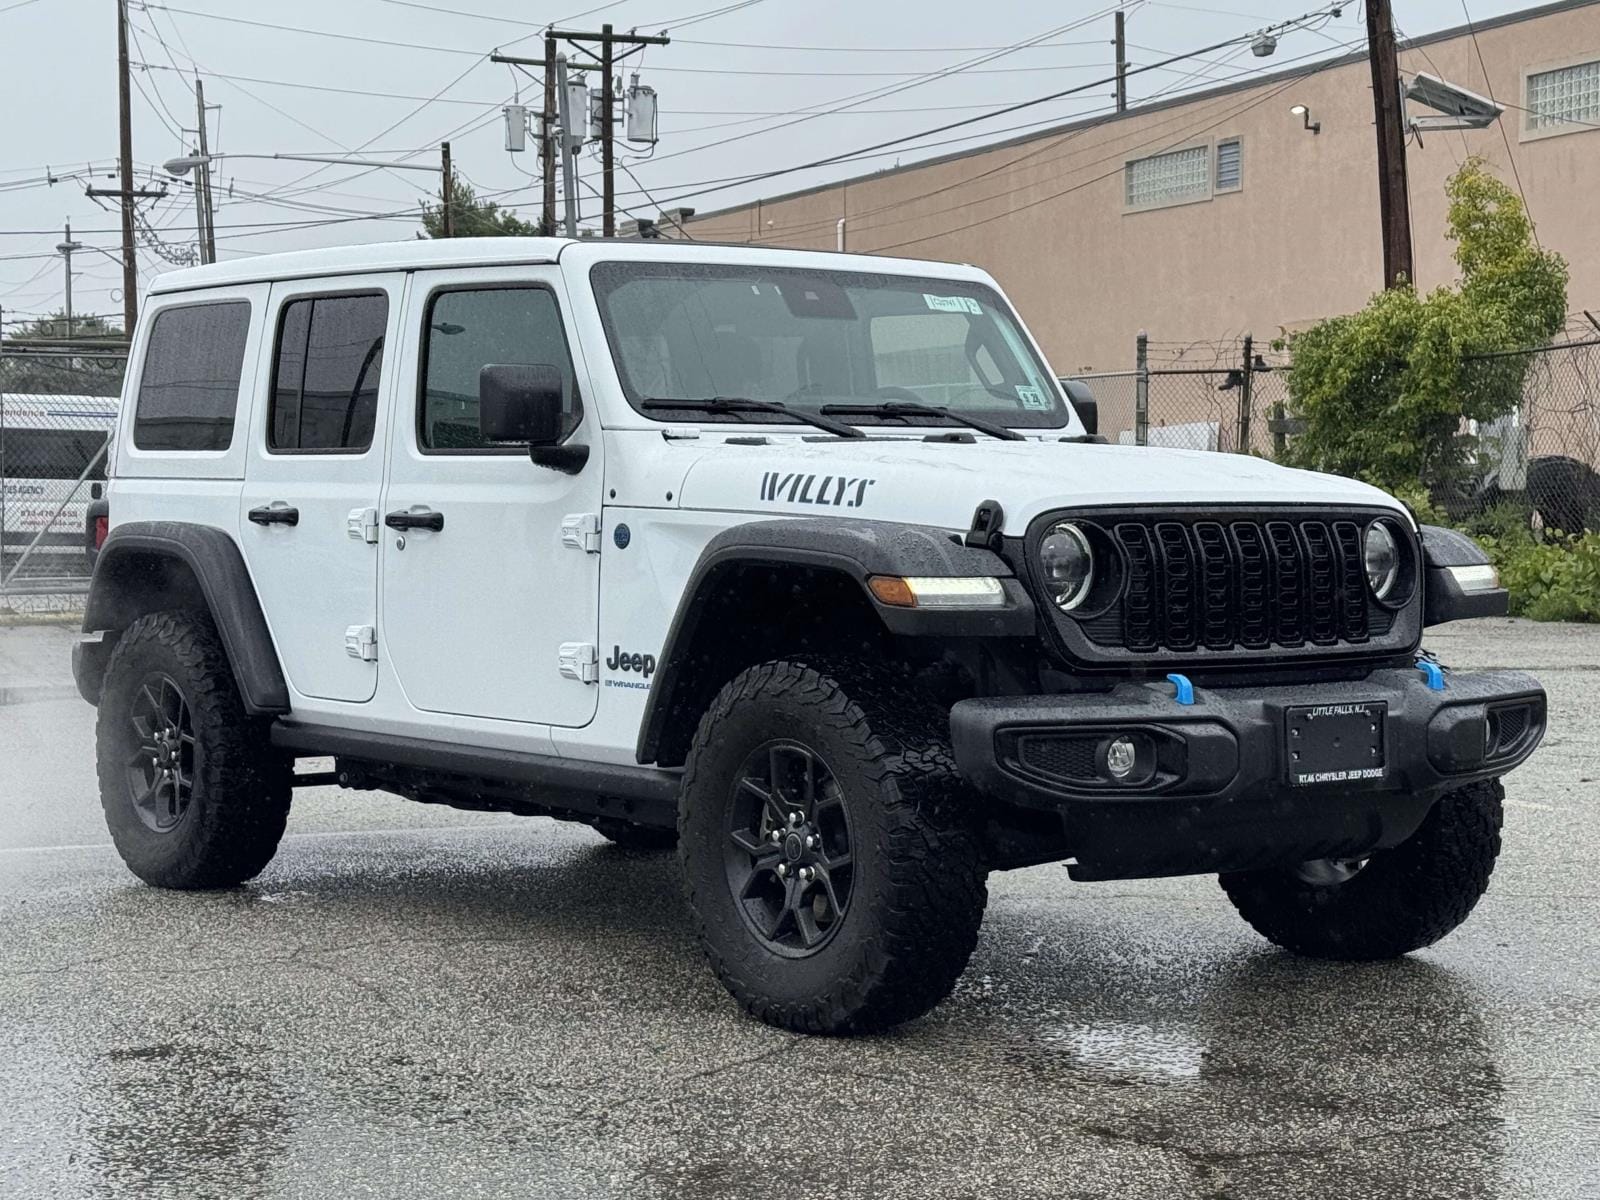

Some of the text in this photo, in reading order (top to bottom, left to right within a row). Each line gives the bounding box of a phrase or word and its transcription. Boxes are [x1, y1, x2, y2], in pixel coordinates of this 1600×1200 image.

[760, 472, 876, 507] WILLYS
[606, 645, 656, 679] Jeep
[612, 680, 653, 690] WRANGLE
[1312, 706, 1333, 716] LITTLE
[1315, 771, 1347, 782] CHRYSLER
[1347, 770, 1362, 779] JEEP
[1362, 768, 1384, 778] DODGE
